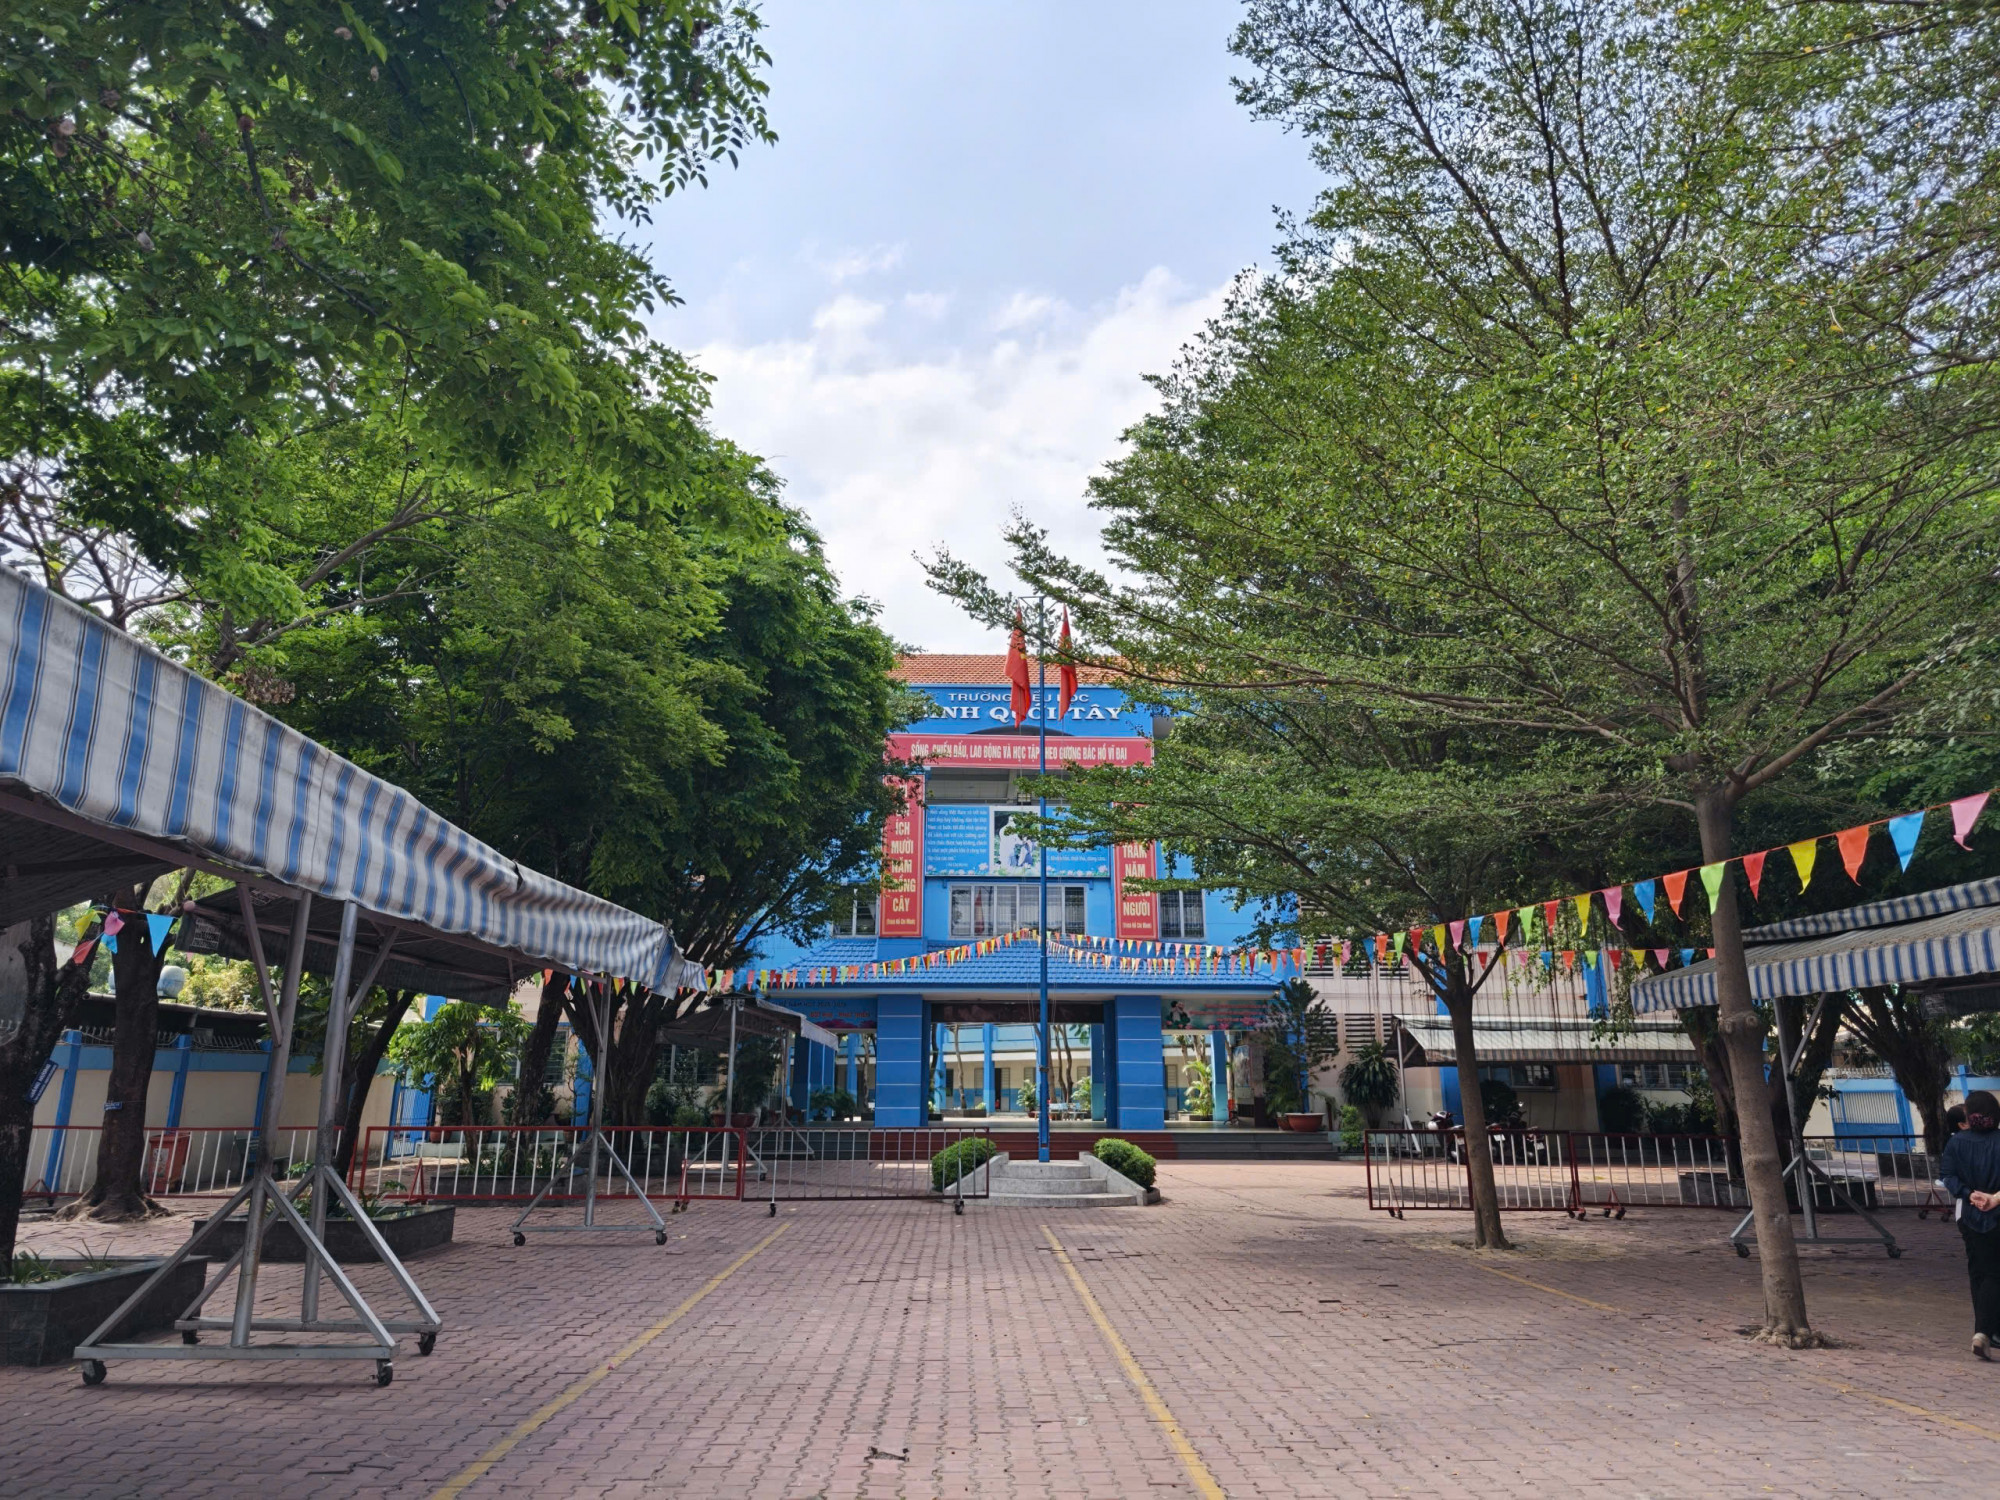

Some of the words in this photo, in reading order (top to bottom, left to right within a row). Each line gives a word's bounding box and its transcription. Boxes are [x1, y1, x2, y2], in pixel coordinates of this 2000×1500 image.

[948, 691, 1012, 702] TRƯỜNG
[921, 702, 981, 719] NH
[1067, 703, 1122, 720] TÂY
[970, 745, 982, 758] LAO
[983, 743, 1002, 761] ĐỘNG
[1003, 743, 1012, 759] VÀ
[1013, 745, 1026, 762] HỌC
[1027, 744, 1040, 762] TẬP
[1044, 746, 1058, 760] HEO
[1059, 745, 1082, 761] GƯƠNG
[1082, 744, 1096, 760] BÁC
[1115, 748, 1127, 763] ĐẠI
[896, 818, 910, 835] ÍCH
[891, 837, 914, 854] MƯỜI
[891, 857, 912, 873] NĂM
[1124, 861, 1146, 878] NĂM
[893, 895, 910, 912] CÂY
[1123, 899, 1150, 917] NGƯỜI
